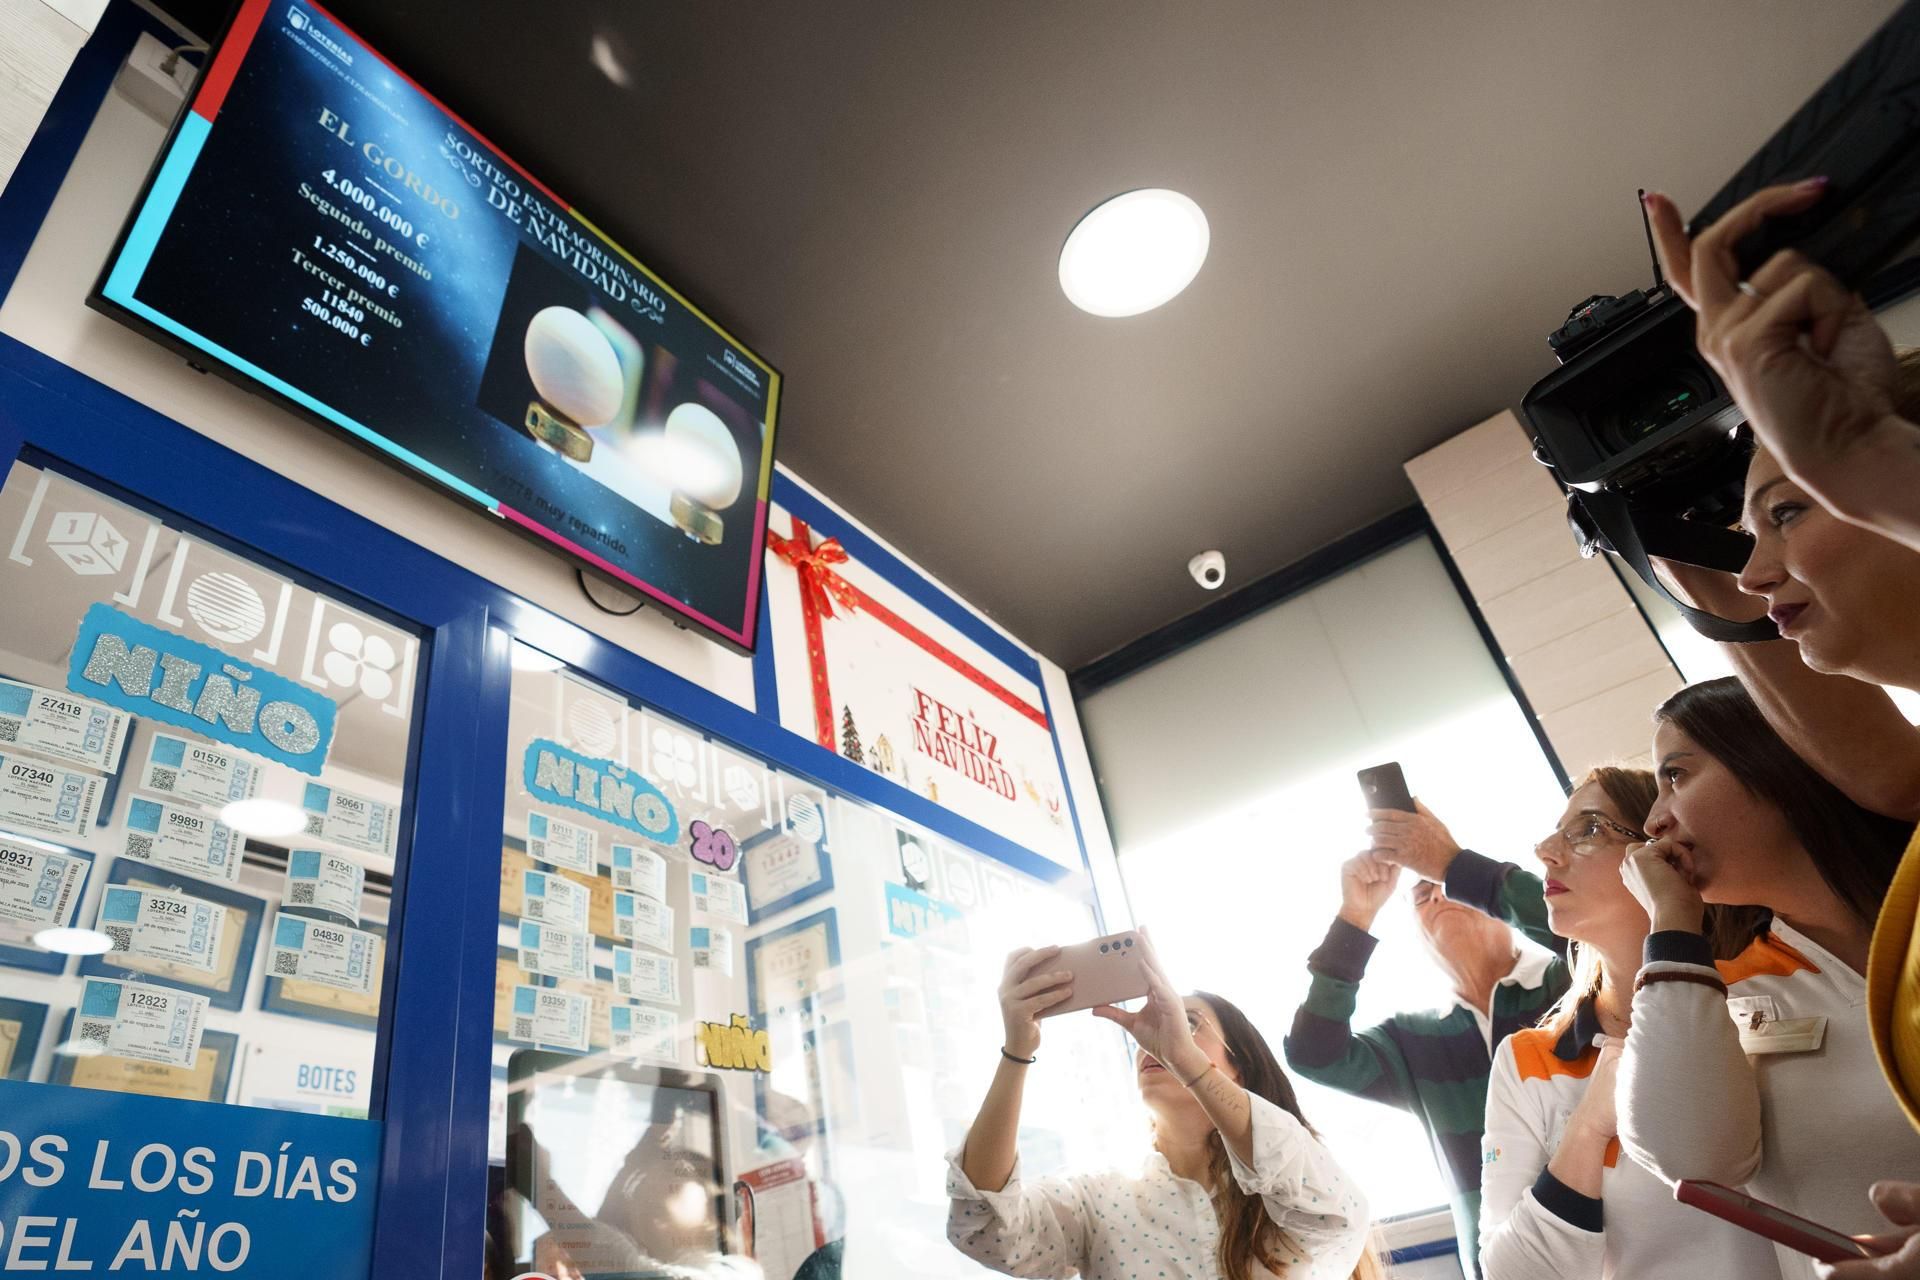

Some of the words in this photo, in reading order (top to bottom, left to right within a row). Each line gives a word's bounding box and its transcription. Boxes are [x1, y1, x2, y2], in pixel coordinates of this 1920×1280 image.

[317, 106, 355, 147] EL
[363, 142, 459, 220] GORDO
[298, 182, 373, 241] Segundo
[373, 237, 432, 281] premio
[321, 168, 414, 239] 4.000.000
[416, 233, 430, 249] €
[445, 132, 521, 198] SORTEO
[523, 193, 667, 313] EXTRAORDINARIO
[313, 235, 386, 290] 1.250.000
[388, 284, 399, 298] €
[486, 186, 523, 225] DE
[525, 216, 627, 302] NAVIDAD
[291, 247, 346, 291] Tercer
[346, 287, 403, 328] premio
[321, 289, 365, 323] 11840
[301, 297, 359, 339] 500.000
[360, 333, 372, 347] €
[536, 496, 567, 521] muy
[568, 516, 629, 558] repartido.
[40, 697, 82, 716] 27418
[81, 632, 321, 755] NIÑO
[913, 687, 1001, 765] FELIZ
[11, 765, 54, 784] 07340
[193, 750, 227, 767] 01576
[912, 717, 1017, 802] NAVIDAD
[170, 812, 204, 829] 99891
[336, 796, 364, 811] 50661
[534, 750, 671, 834] NIÑO
[0, 849, 33, 867] 0931
[690, 820, 736, 871] 20
[150, 899, 187, 915] 33734
[313, 928, 344, 943] 04830
[130, 993, 168, 1009] 12823
[696, 1013, 772, 1073] NIÑO
[297, 1063, 357, 1093] BOTES
[88, 1139, 216, 1196] LOS
[233, 1141, 358, 1203] DÍAS
[0, 1216, 93, 1270] EL
[108, 1208, 251, 1272] AÑO
